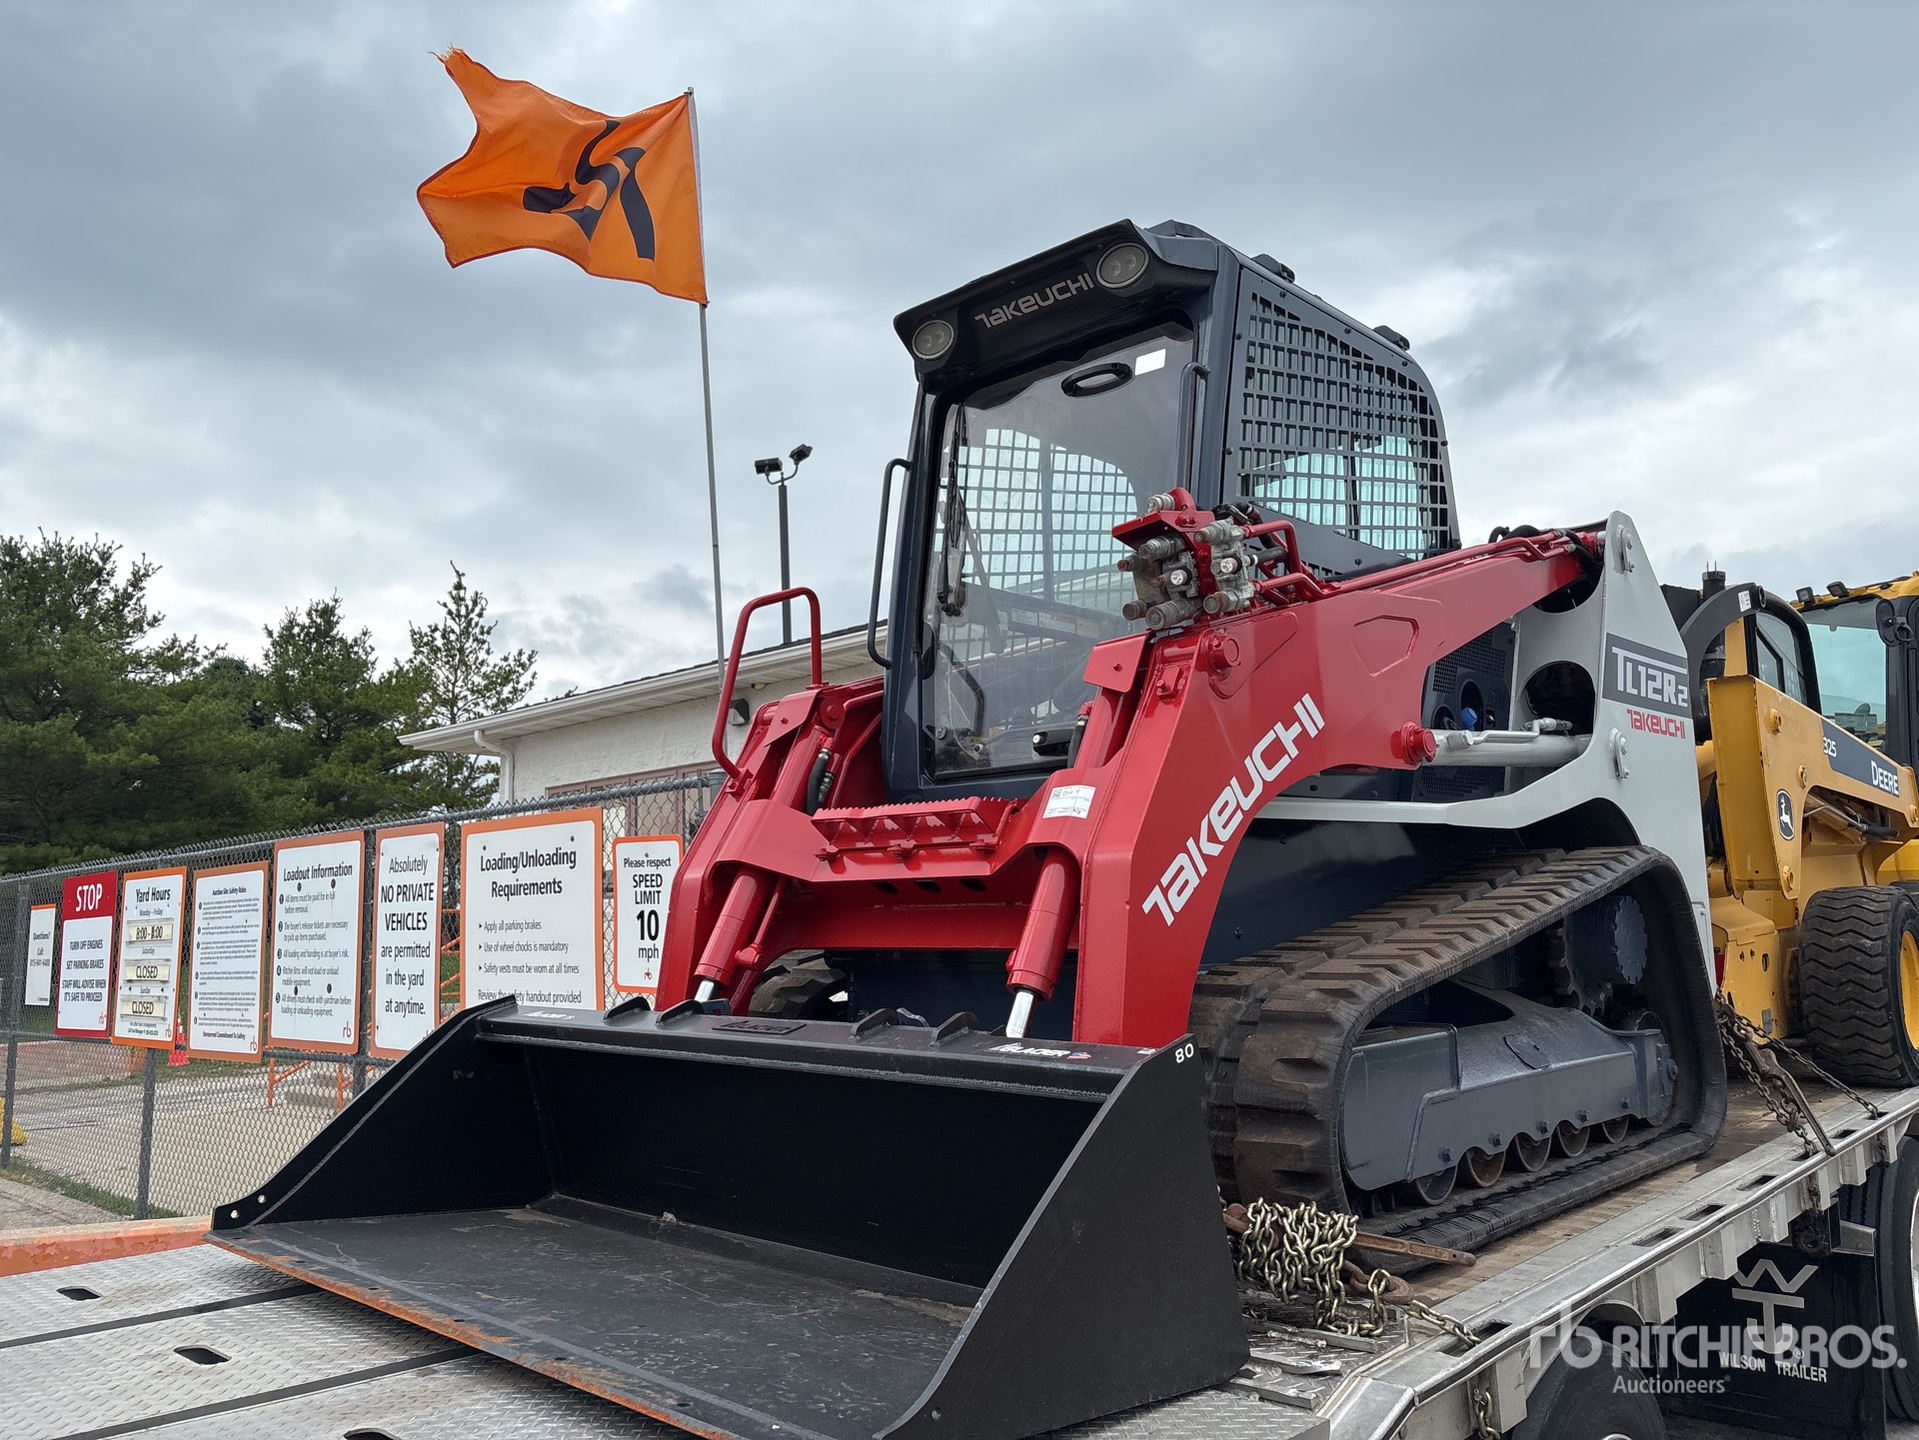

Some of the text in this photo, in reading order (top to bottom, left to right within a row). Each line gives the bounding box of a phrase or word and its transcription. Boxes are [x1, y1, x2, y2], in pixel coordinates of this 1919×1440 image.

[974, 272, 1094, 329] TAKEUCHI
[1627, 709, 1685, 739] TAKEUCHI
[1823, 736, 1836, 758] 325
[1870, 760, 1899, 795] DEERE
[1142, 693, 1325, 926] TAKEUCHI
[389, 855, 428, 876] Absolutely
[481, 847, 576, 874] Loading/Unloading
[624, 857, 671, 870] Please respect
[284, 862, 352, 881] Loadout Information
[492, 878, 562, 901] Requirements
[633, 874, 662, 888] SPEED
[76, 884, 102, 912] STOP
[136, 887, 170, 903] Yard Hours
[308, 893, 312, 901] be
[381, 882, 434, 903] NO PRIVATE
[635, 890, 661, 904] LIMIT
[285, 905, 295, 914] before
[385, 912, 428, 931] VEHICLES
[484, 921, 498, 933] Apply
[505, 920, 524, 933] parking
[524, 919, 542, 930] brakes
[636, 909, 659, 941] 10
[136, 927, 147, 940] 8:00
[70, 941, 79, 950] TURN
[87, 940, 103, 949] ENGINES
[381, 941, 431, 962] are permitted
[484, 940, 569, 954] Use of wheel chocks is mandatory
[638, 944, 659, 962] mph
[73, 960, 89, 969] PARKING
[90, 959, 104, 968] BRAKES
[136, 966, 158, 978] CLOSED
[484, 963, 498, 976] Safety
[499, 963, 511, 973] vests
[512, 964, 525, 973] must
[526, 963, 532, 973] be
[534, 965, 547, 974] worn
[548, 964, 554, 974] at
[564, 963, 579, 974] times
[62, 980, 72, 989] STAFF
[82, 979, 94, 988] ADVISE
[95, 979, 106, 988] WHEN
[386, 969, 424, 990] in the yard
[71, 992, 80, 1001] SAFE
[80, 992, 85, 1001] TO
[86, 992, 102, 1002] PROCEED
[478, 989, 497, 1000] Review
[526, 990, 551, 1003] handout
[553, 990, 582, 1005] provided
[132, 1001, 154, 1015] CLOSED
[385, 998, 426, 1018] at anytime.
[1175, 1043, 1194, 1064] 80
[1719, 1351, 1827, 1383] WILSON TRAILER
